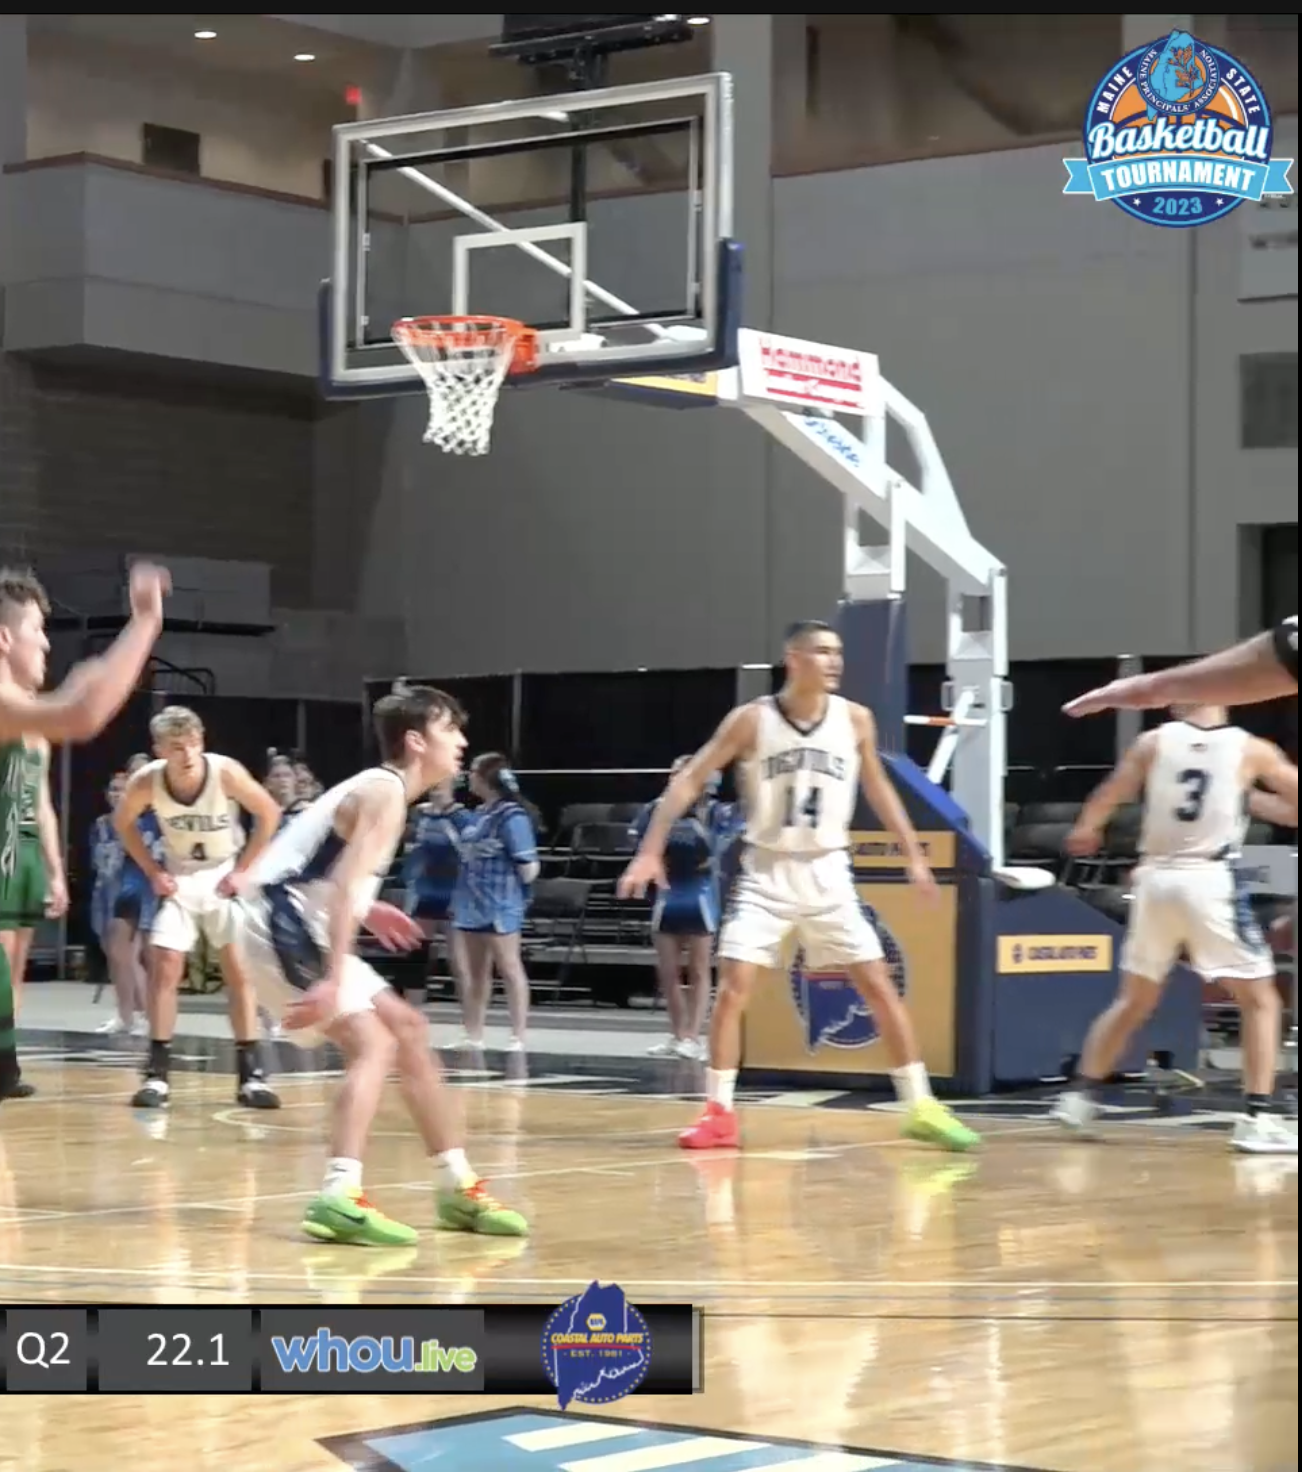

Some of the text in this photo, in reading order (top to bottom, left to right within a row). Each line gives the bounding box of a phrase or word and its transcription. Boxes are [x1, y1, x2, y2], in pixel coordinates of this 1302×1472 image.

[784, 786, 823, 829] 14
[1175, 767, 1210, 822] 3
[192, 842, 208, 860] 4
